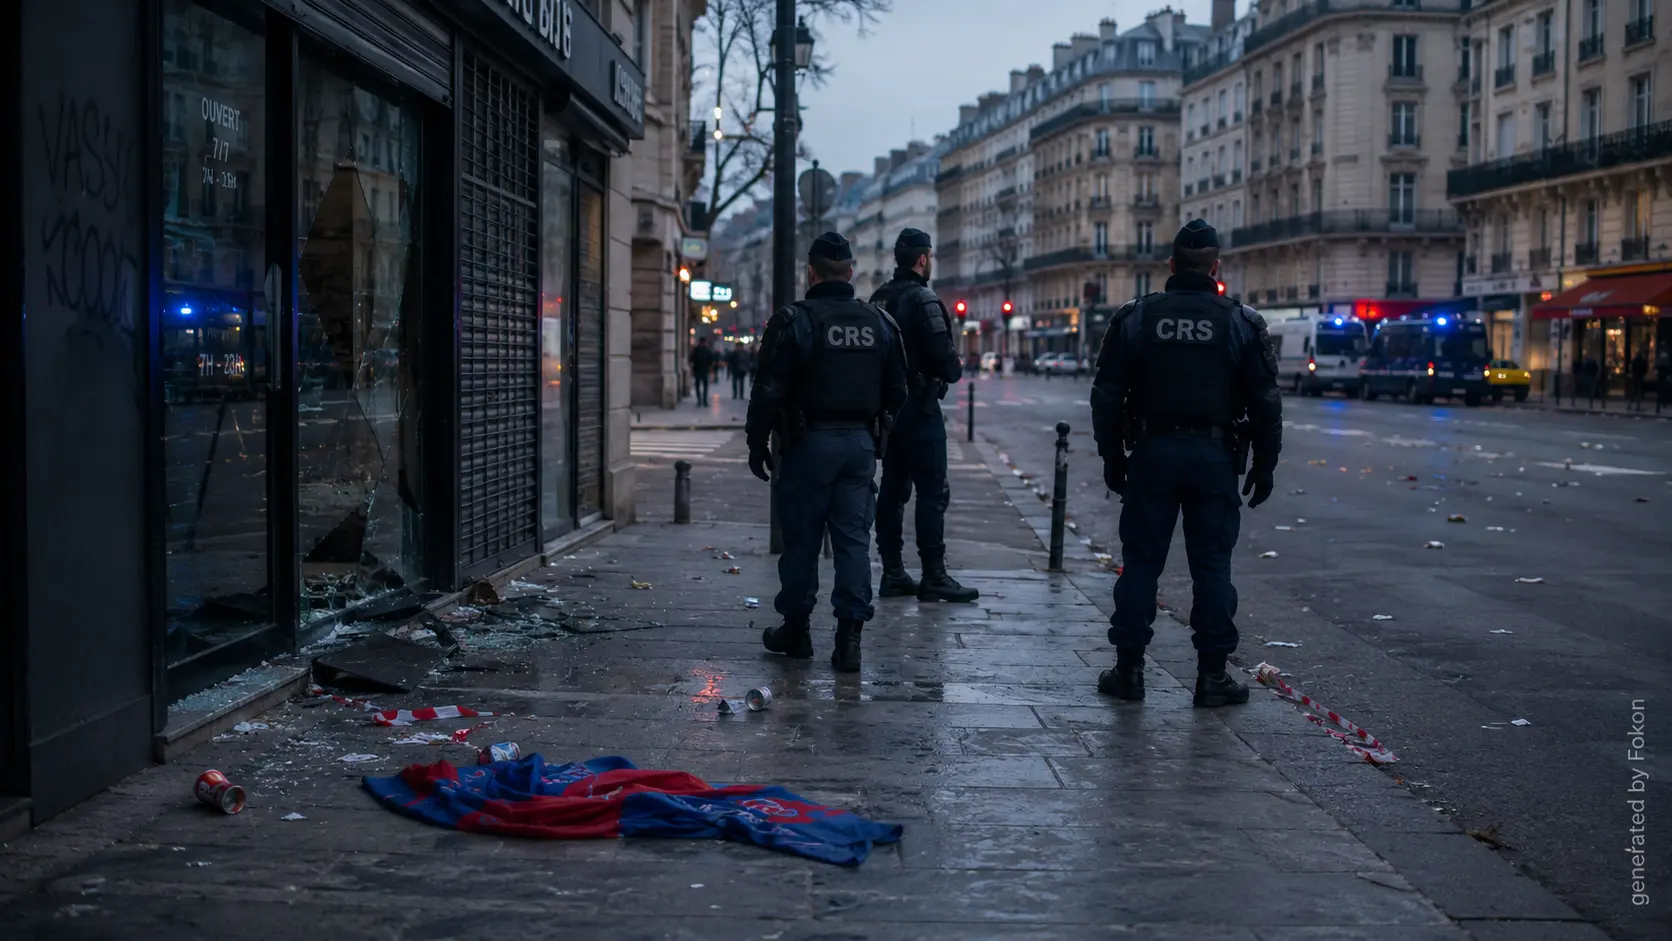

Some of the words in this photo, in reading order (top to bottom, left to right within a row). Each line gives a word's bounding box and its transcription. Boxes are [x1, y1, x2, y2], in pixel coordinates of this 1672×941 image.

[201, 96, 240, 132] OUVERT
[212, 136, 230, 163] 7/7
[827, 325, 875, 347] CRS
[1156, 318, 1213, 341] CRS
